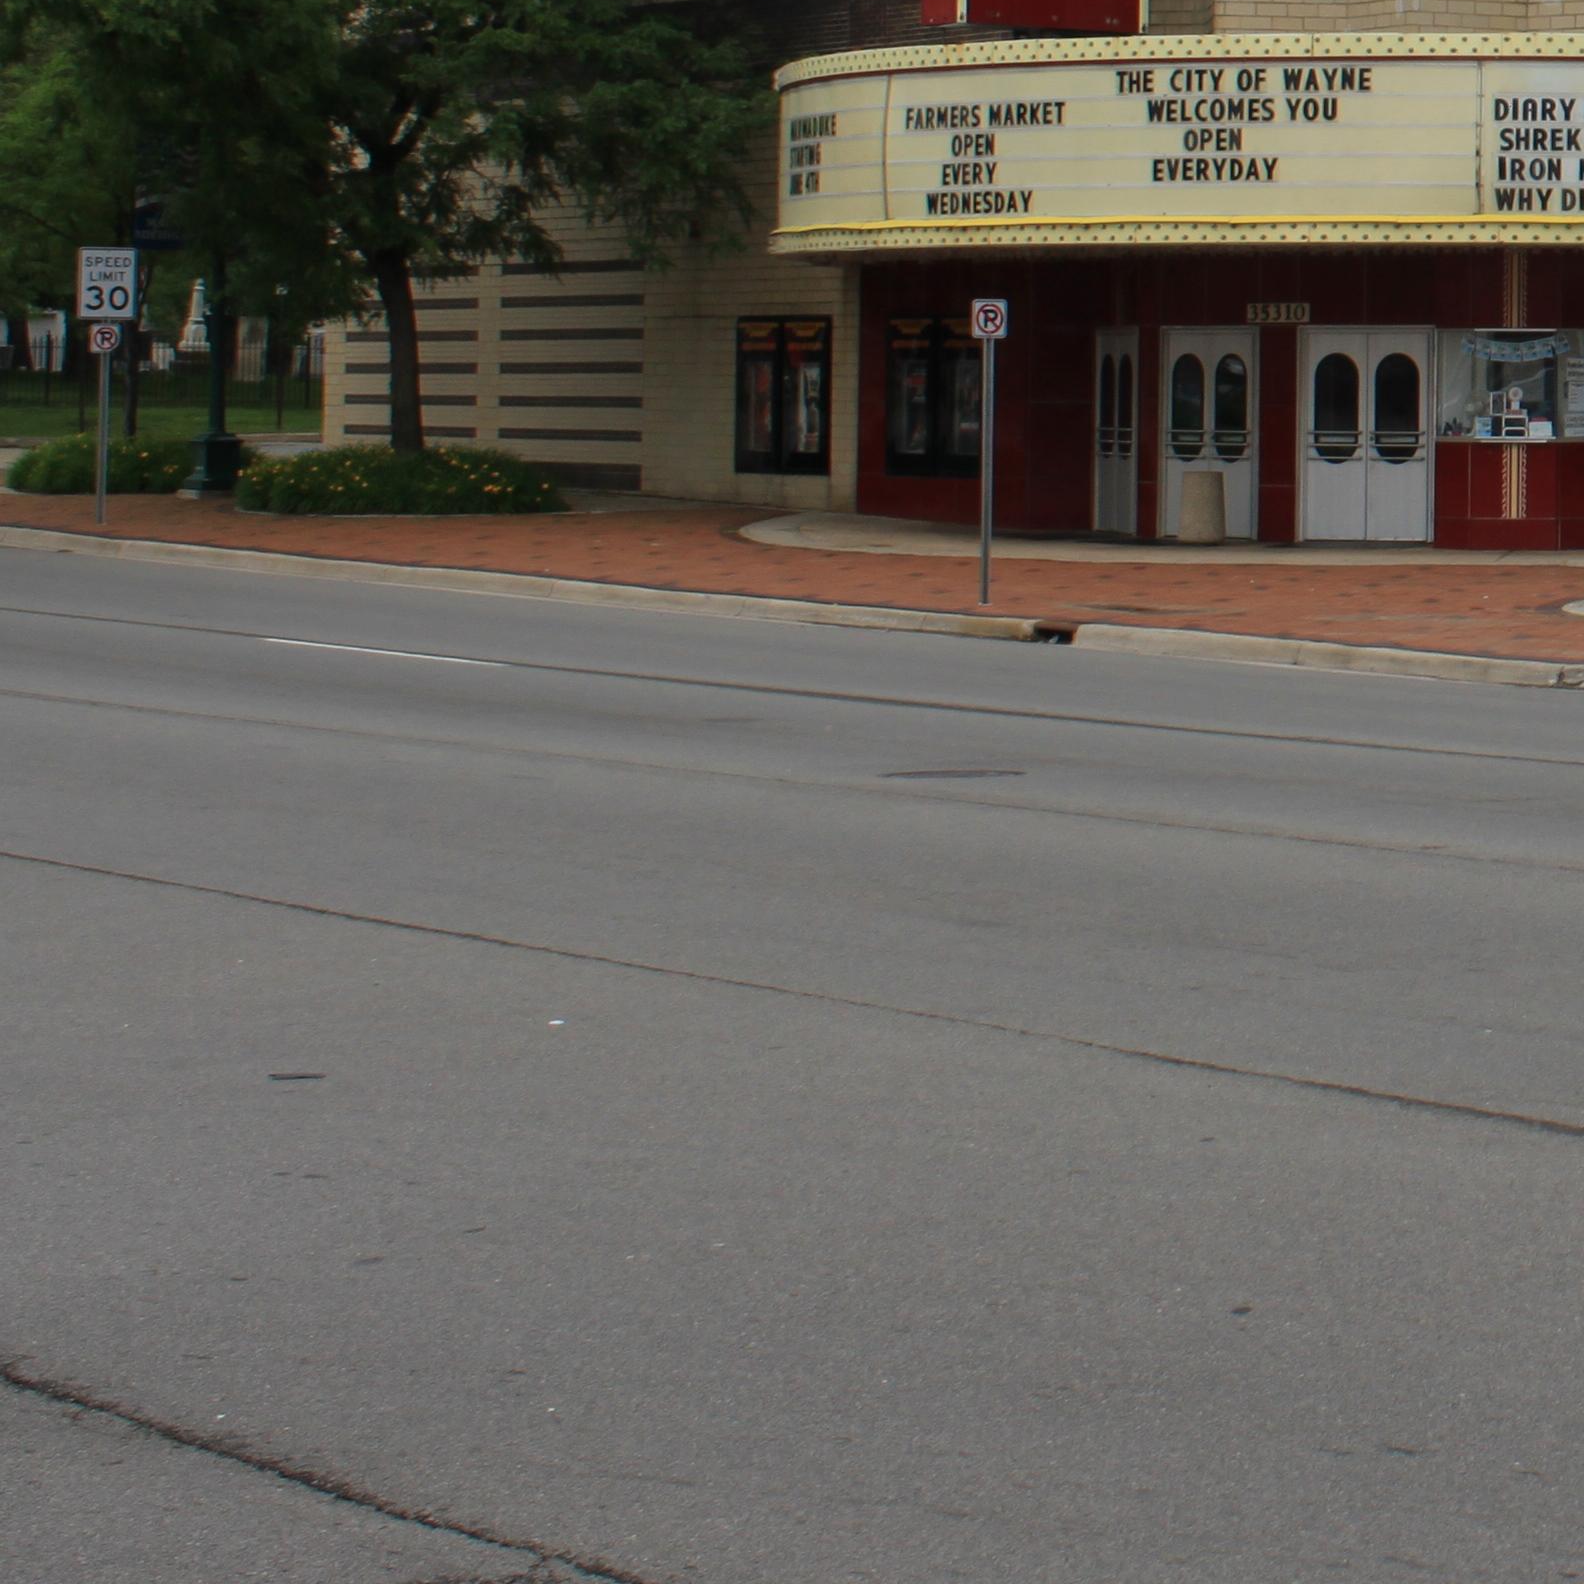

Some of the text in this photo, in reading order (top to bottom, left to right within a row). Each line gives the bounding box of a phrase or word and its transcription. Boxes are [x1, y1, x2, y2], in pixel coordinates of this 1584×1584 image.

[1116, 68, 1372, 93] THE CITY OF WAYNE
[906, 101, 1065, 130] FARMERS MARKET
[1148, 98, 1338, 122] WELCOMES YOU
[1494, 98, 1576, 121] DIARY
[951, 133, 995, 157] OPEN
[1184, 128, 1242, 151] OPEN
[1500, 128, 1581, 151] SHREK
[941, 162, 997, 186] EVERY
[1152, 158, 1279, 182] EVERYDAY
[1498, 156, 1562, 181] IRON
[926, 190, 1033, 215] WEDNESDAY
[1495, 188, 1553, 211] WHY
[85, 256, 132, 268] SPEED
[90, 272, 126, 282] LIMIT
[85, 285, 129, 311] 30
[1249, 303, 1305, 321] 35310
